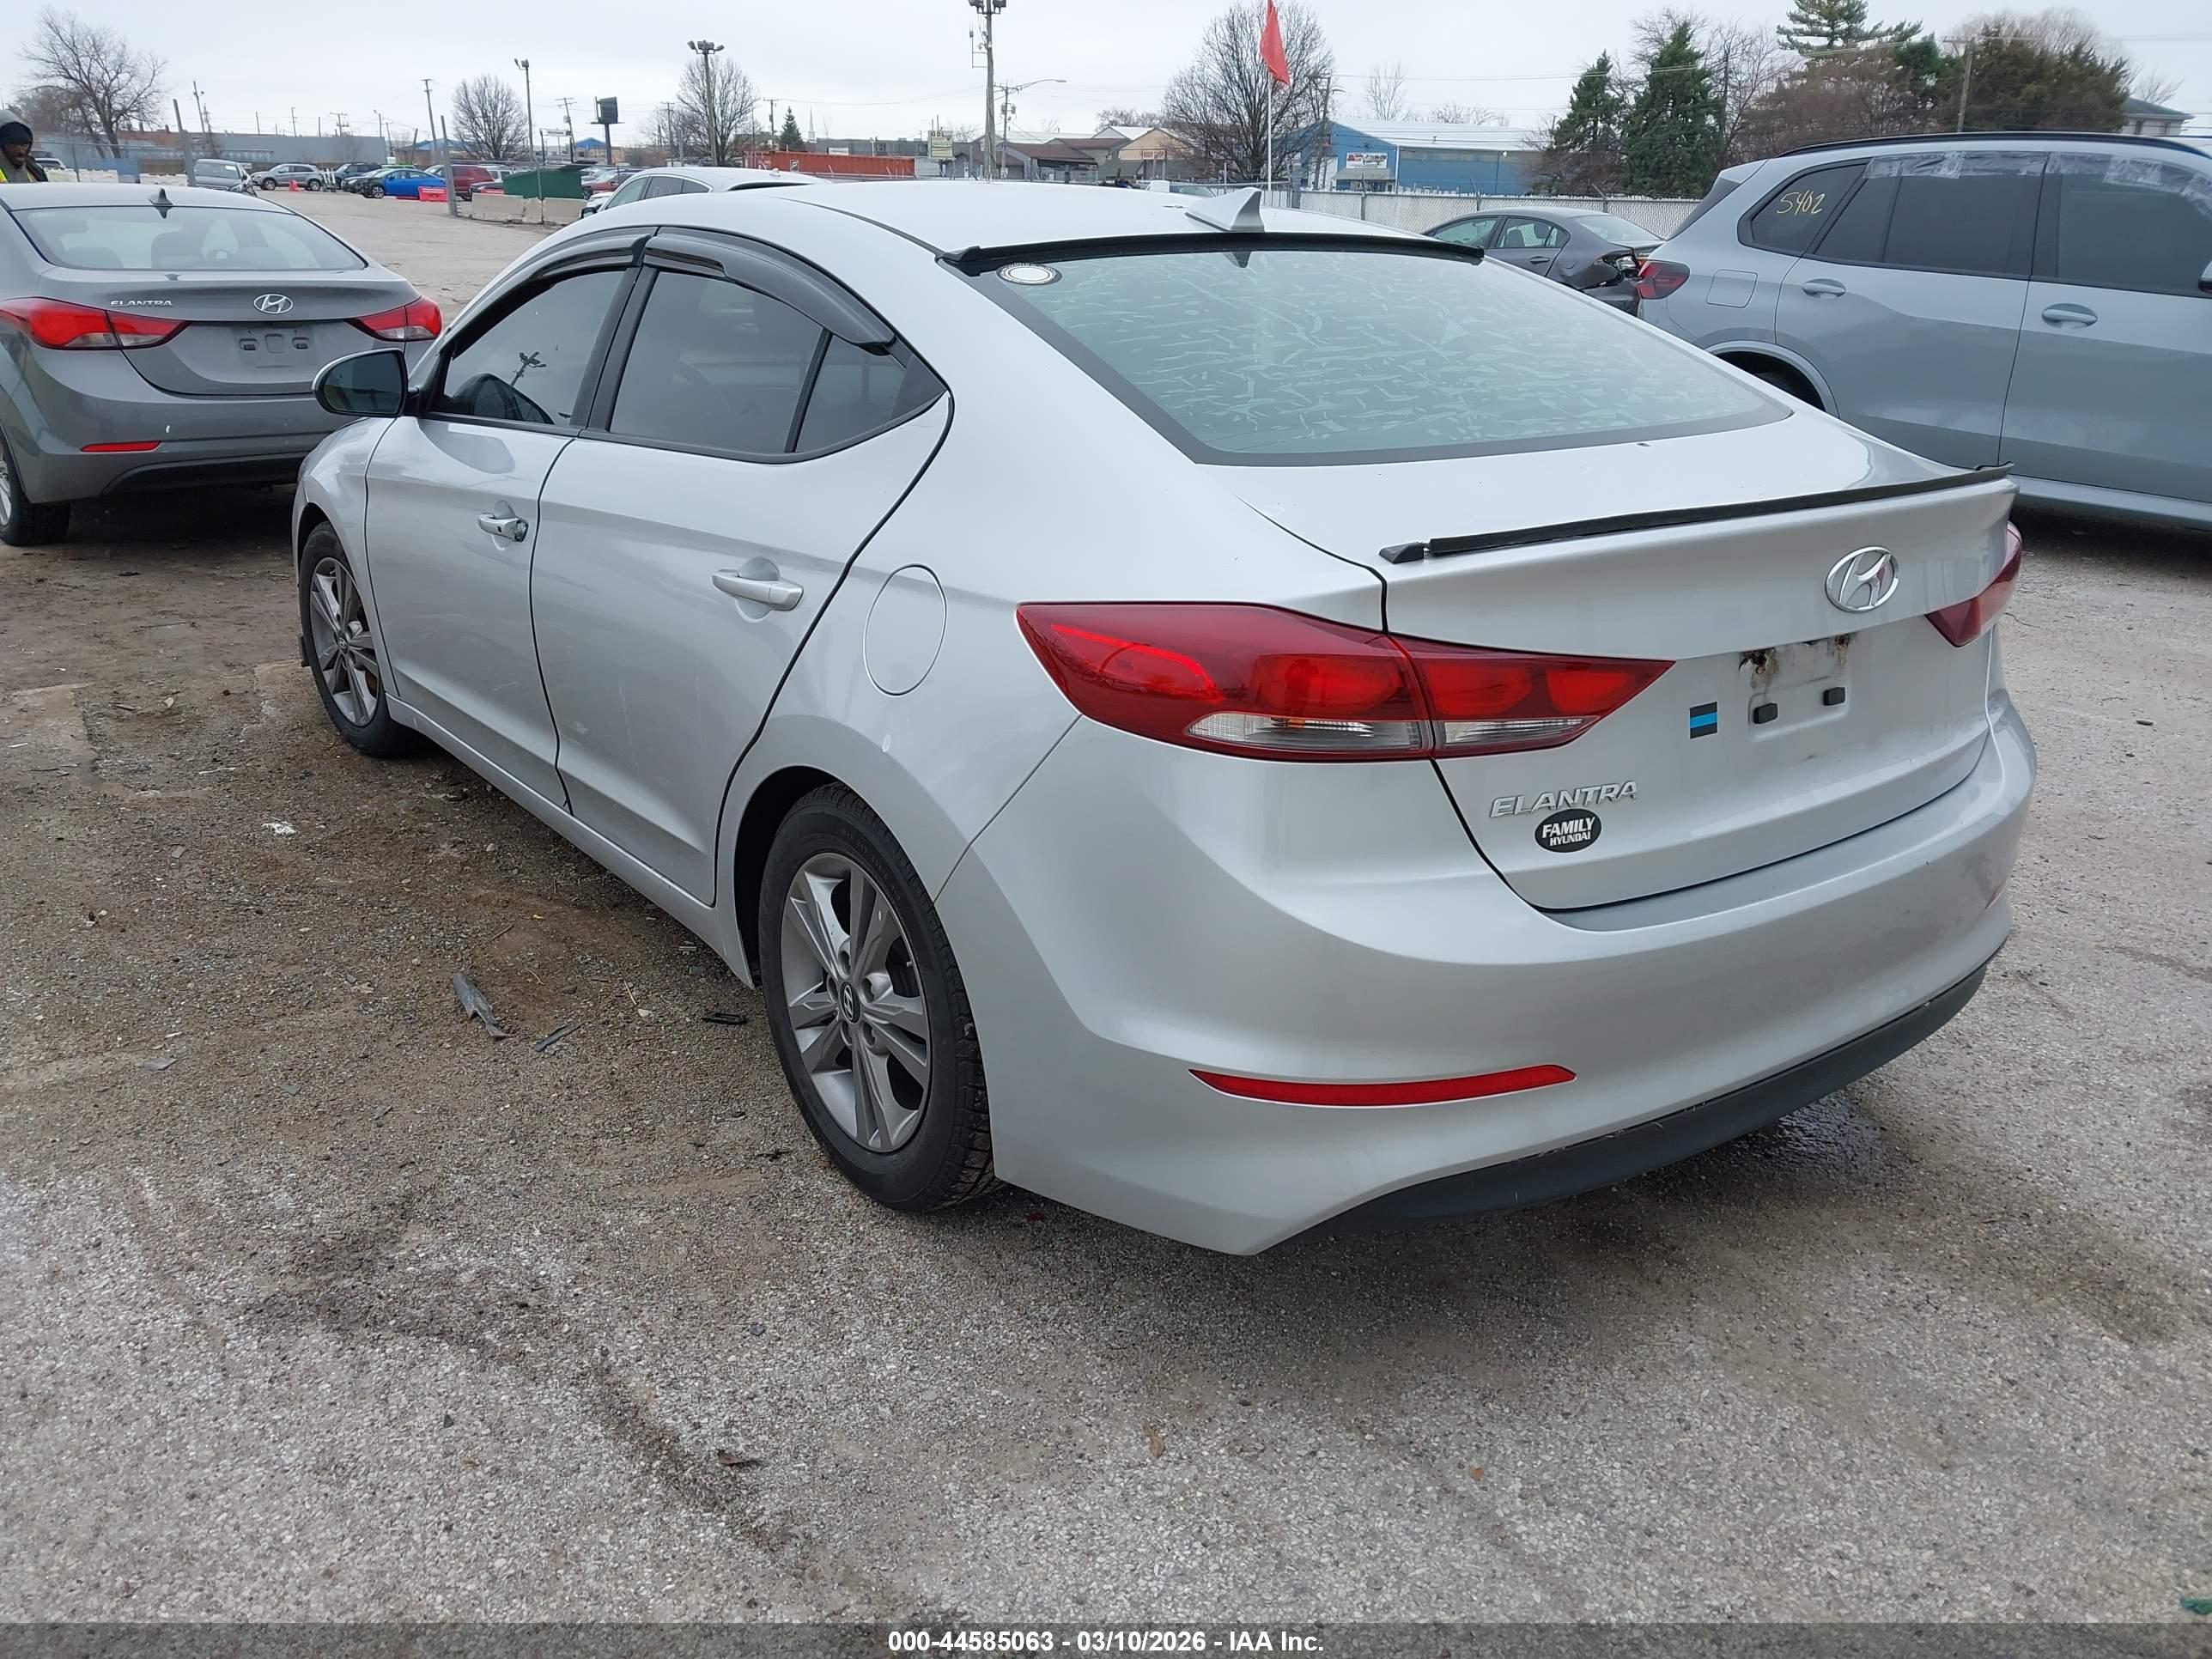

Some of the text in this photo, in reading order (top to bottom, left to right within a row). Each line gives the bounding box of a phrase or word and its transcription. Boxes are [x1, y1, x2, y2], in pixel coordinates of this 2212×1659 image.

[1777, 190, 1826, 216] 5402
[1490, 781, 1638, 818] ELANTRA
[1541, 816, 1596, 839] FAMILY
[1549, 831, 1591, 847] HYUNDAI
